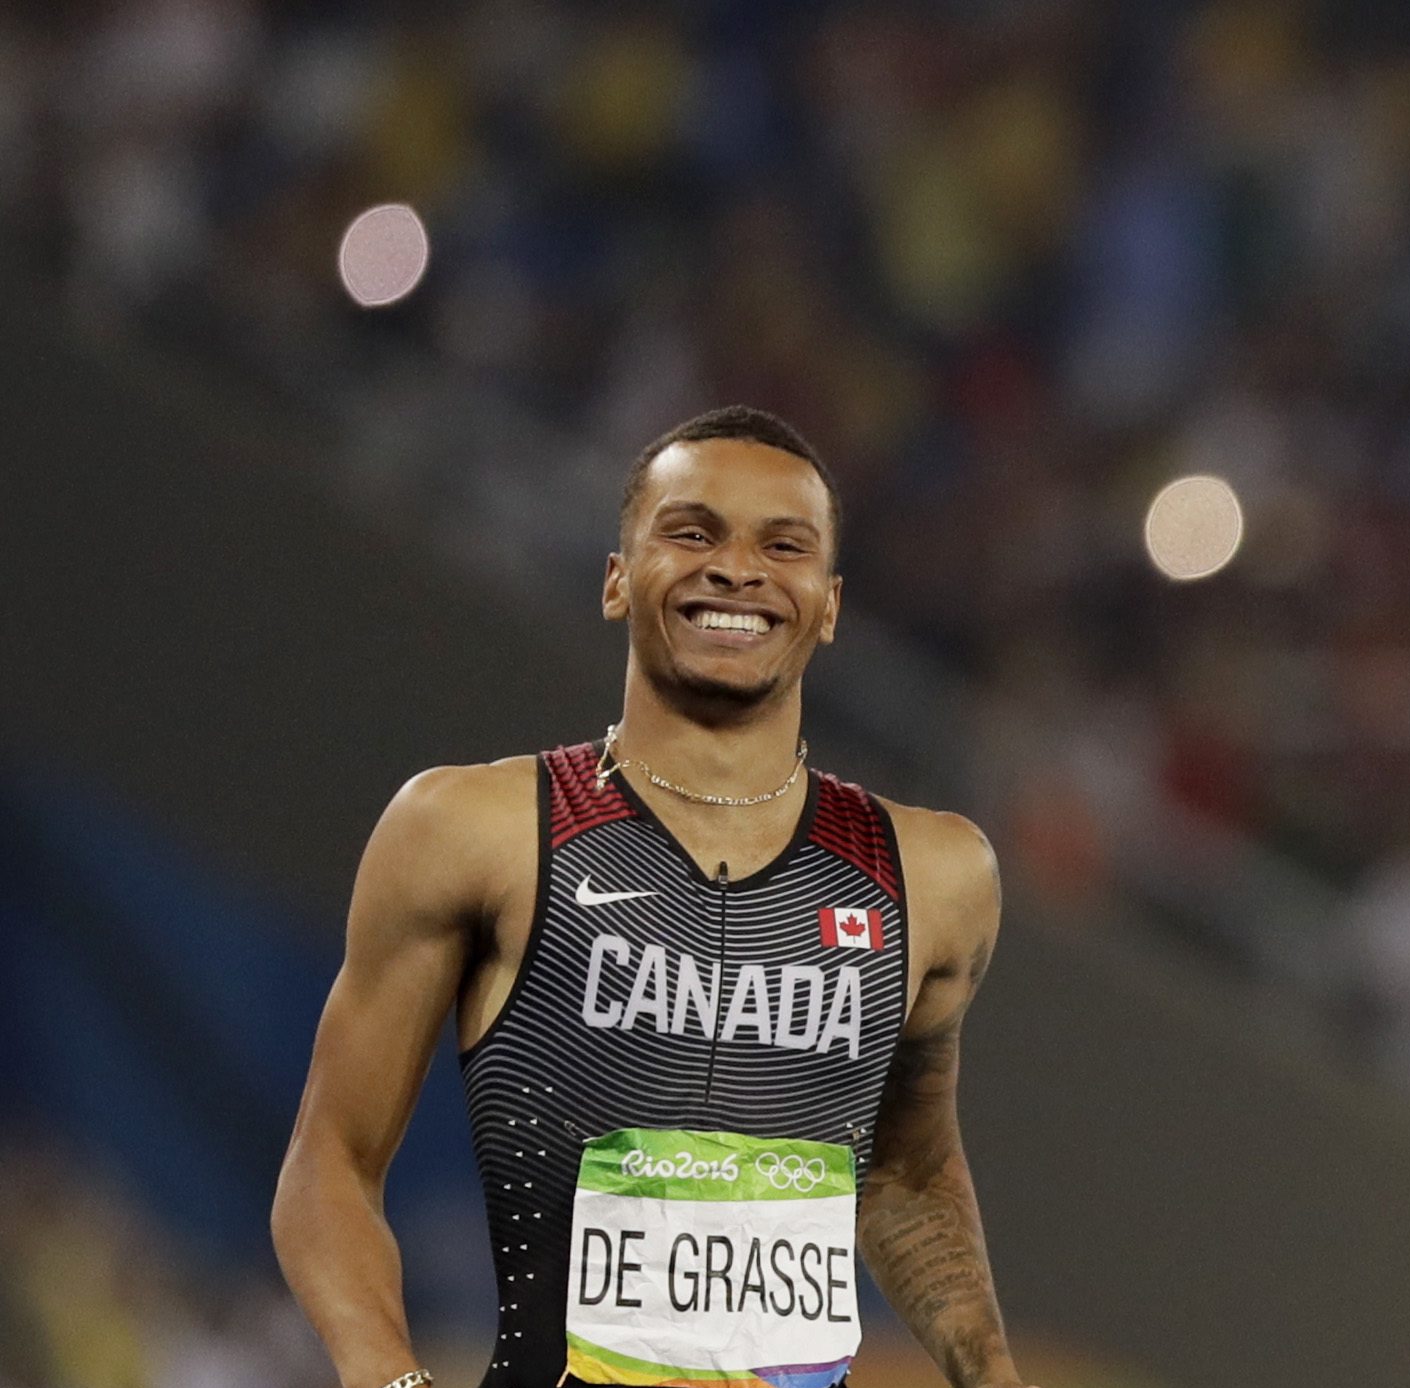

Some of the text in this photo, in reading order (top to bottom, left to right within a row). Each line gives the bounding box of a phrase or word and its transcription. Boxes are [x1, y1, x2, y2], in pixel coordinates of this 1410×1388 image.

[582, 934, 861, 1060] CANADA
[578, 1226, 646, 1308] DE
[667, 1231, 853, 1323] GRASSE
